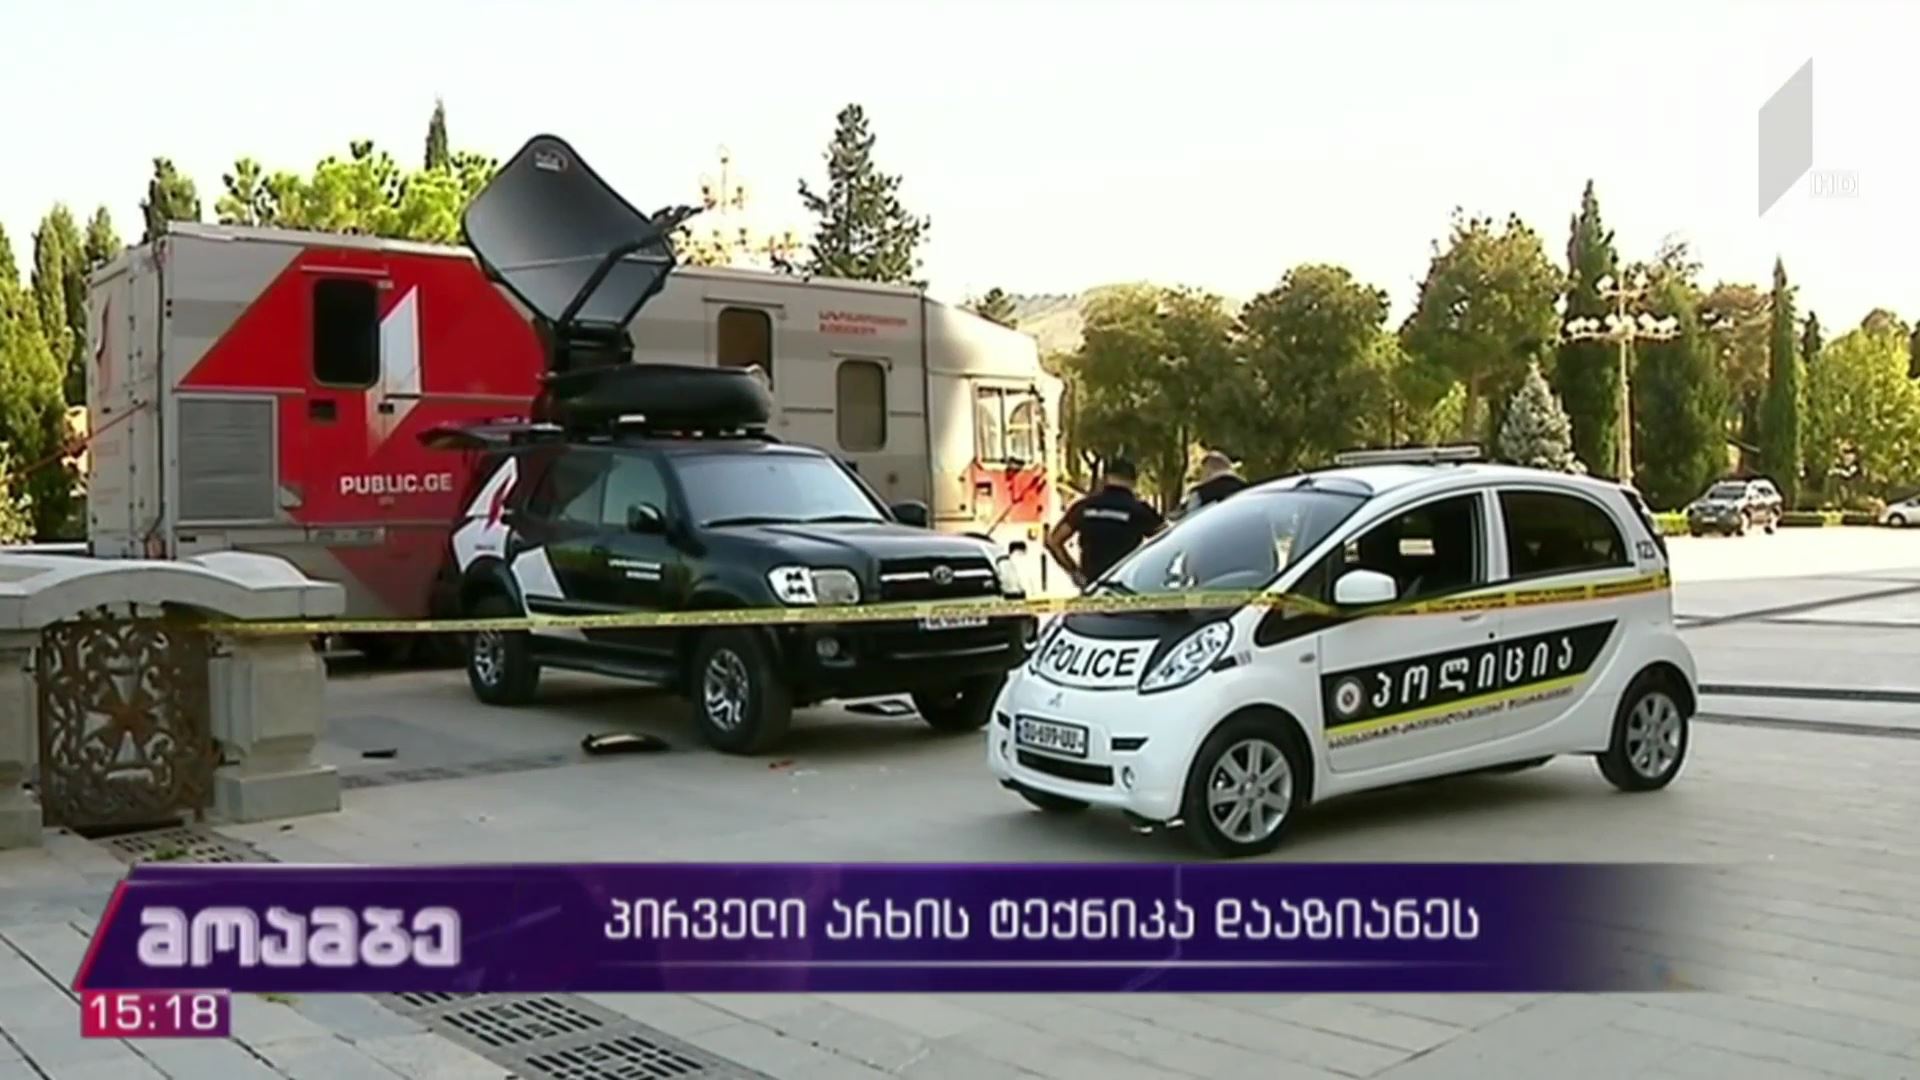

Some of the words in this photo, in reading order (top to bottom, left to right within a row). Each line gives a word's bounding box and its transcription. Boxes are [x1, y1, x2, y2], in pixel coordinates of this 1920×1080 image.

[340, 473, 453, 495] PUBLIC.GE
[1045, 637, 1140, 678] POLICE
[1372, 636, 1574, 708] პოლიცია
